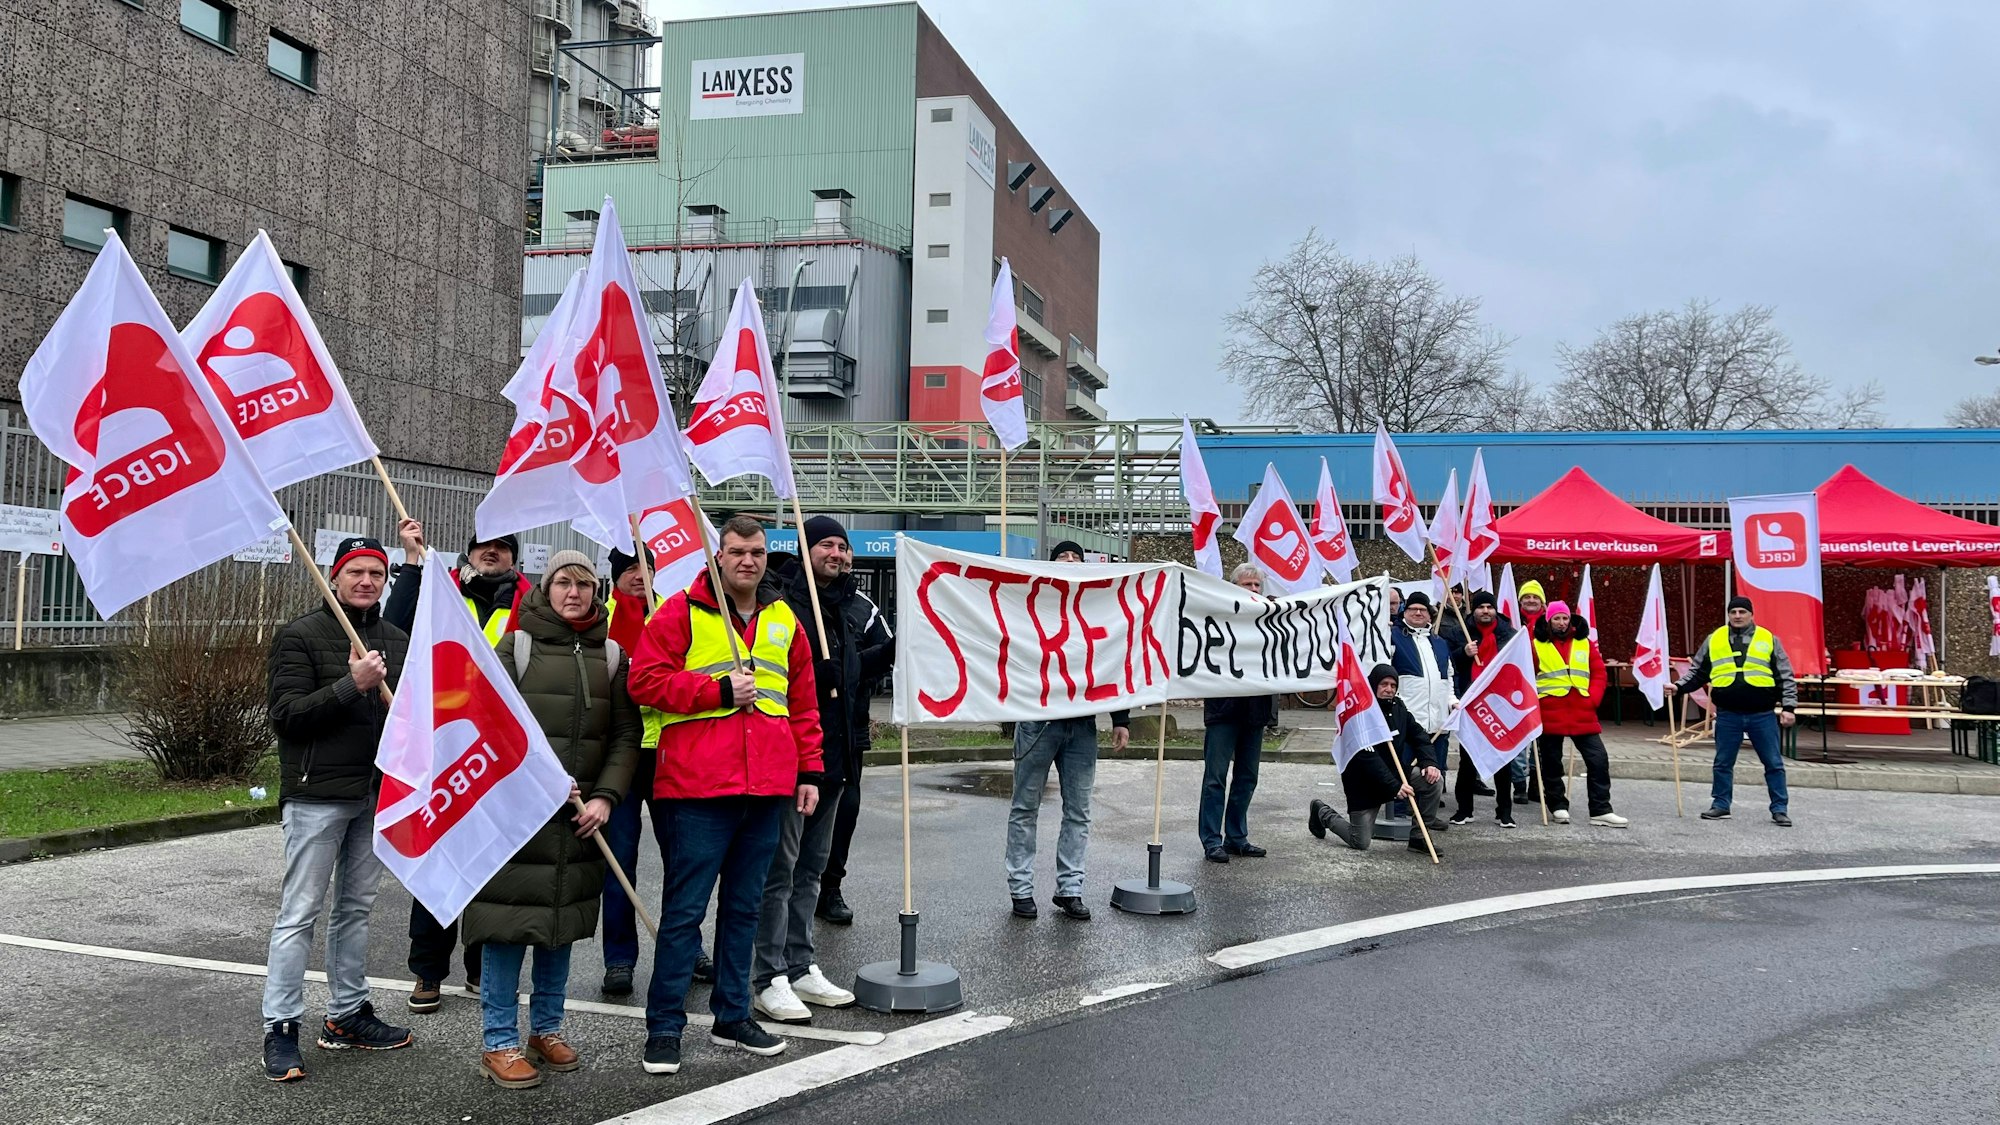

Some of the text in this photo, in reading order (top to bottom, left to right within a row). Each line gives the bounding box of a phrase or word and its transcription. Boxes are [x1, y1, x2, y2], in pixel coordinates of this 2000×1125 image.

[702, 66, 793, 96] LANXESS
[764, 97, 792, 105] Chemistry
[969, 122, 994, 175] LANXESS
[865, 542, 890, 552] TOR
[1526, 538, 1658, 552] Bezirk Leverkusen
[916, 561, 1171, 718] STREIK
[1177, 572, 1244, 678] bei
[1473, 701, 1507, 740] IGBCE
